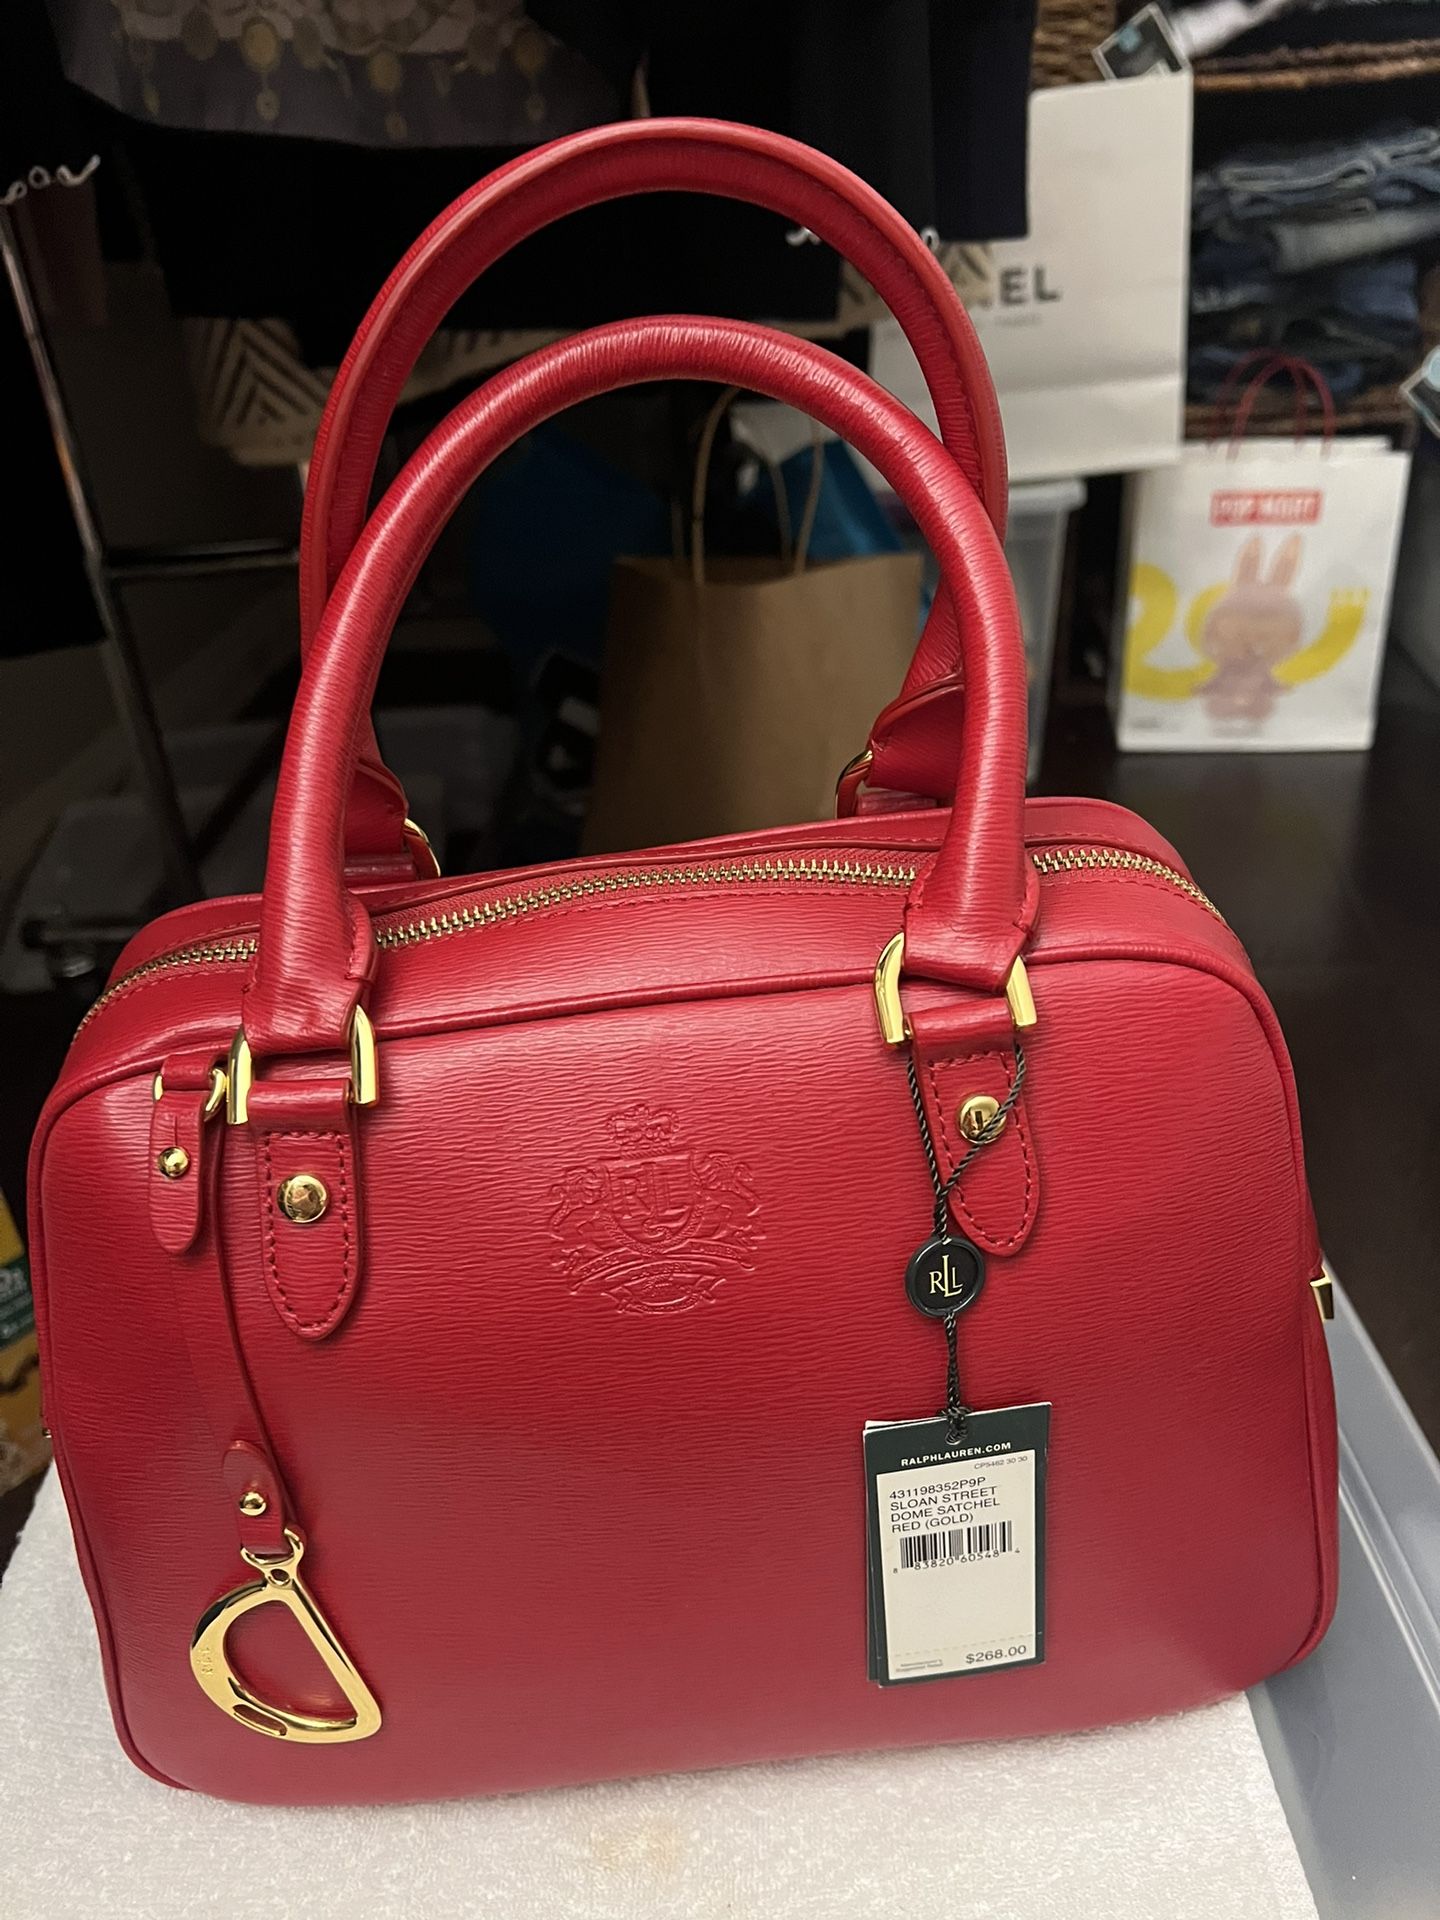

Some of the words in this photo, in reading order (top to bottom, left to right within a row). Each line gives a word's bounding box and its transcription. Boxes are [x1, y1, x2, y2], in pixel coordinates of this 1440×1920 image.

[900, 1441, 1012, 1467] RALPHLAUREN.COM
[889, 1476, 986, 1500] 431198352P9P
[890, 1496, 938, 1512] SLOAN
[942, 1486, 998, 1504] STREET
[891, 1507, 933, 1523] DOME
[937, 1497, 1001, 1516] SATCHEL
[892, 1520, 921, 1534] RED
[925, 1512, 974, 1530] (GOLD)
[913, 1557, 954, 1571] 83820
[960, 1549, 1000, 1563] 60548
[965, 1644, 1027, 1665] $268.00
